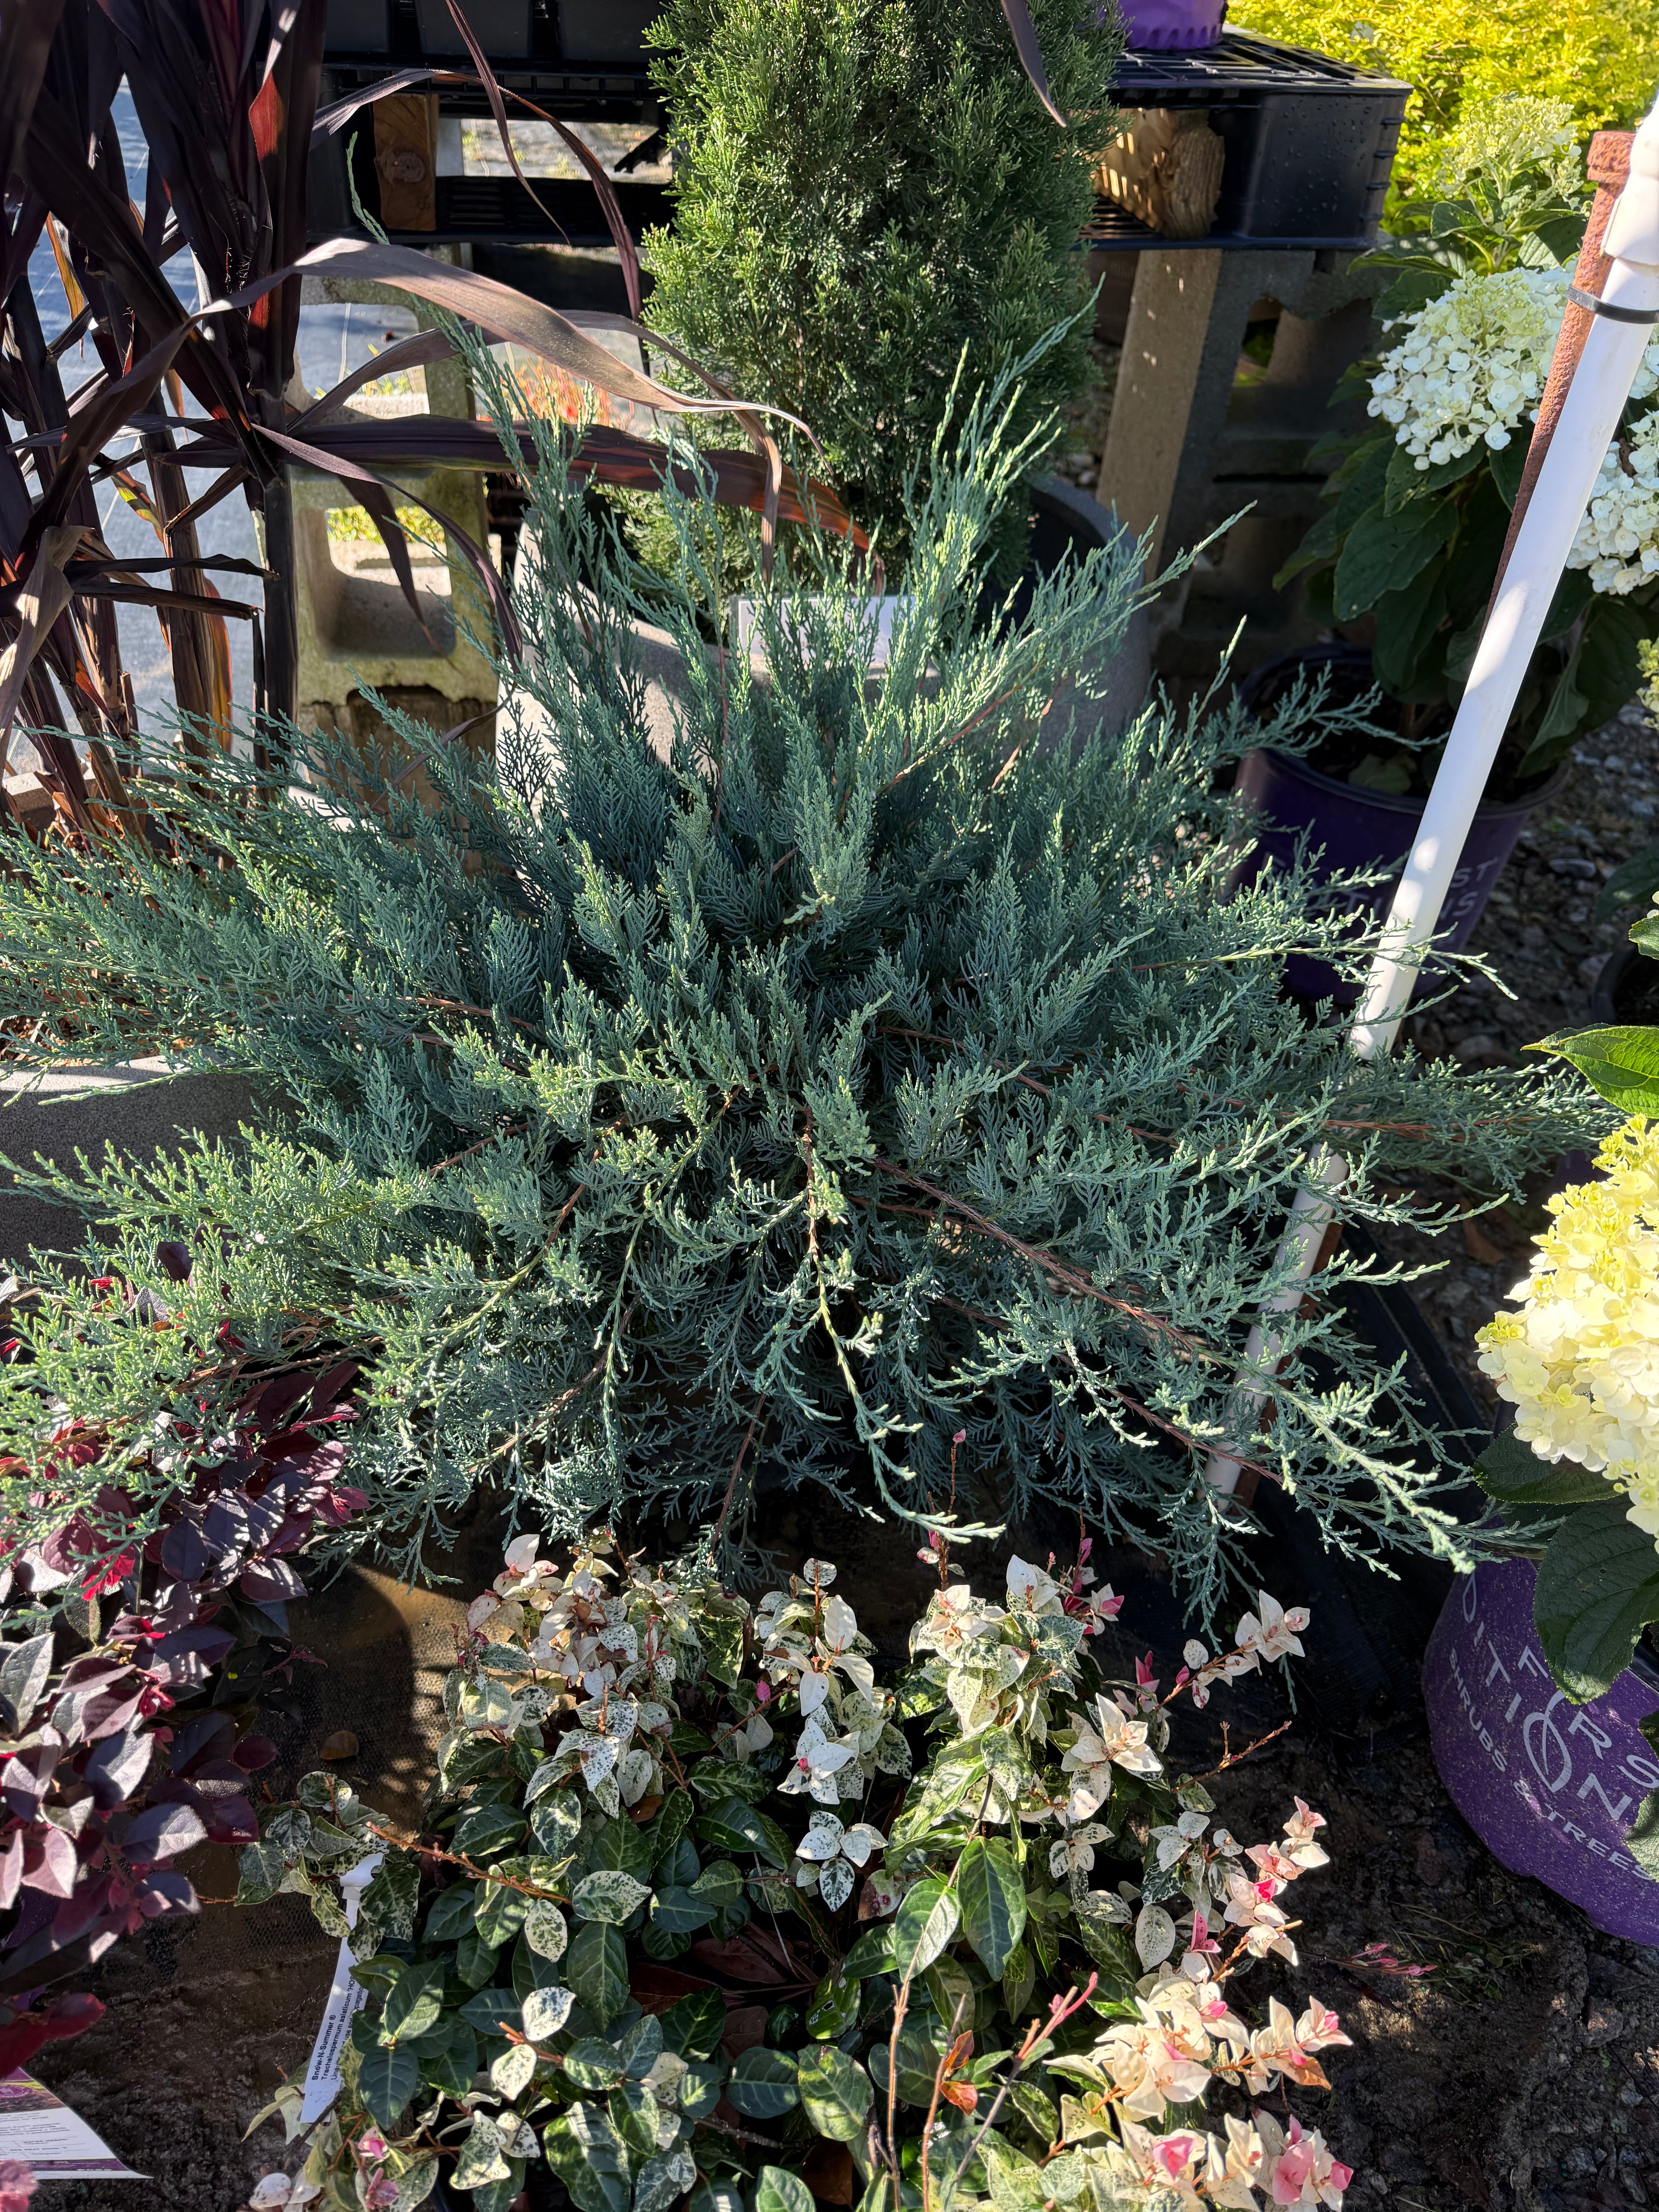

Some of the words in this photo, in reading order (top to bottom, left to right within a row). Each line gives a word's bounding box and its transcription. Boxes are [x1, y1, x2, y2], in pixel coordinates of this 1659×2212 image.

[1449, 1646, 1508, 1773] SHRUBS
[1513, 1778, 1535, 1804] &
[1545, 1803, 1654, 1881] TREES
[1462, 1573, 1632, 1820] DITION
[311, 2022, 334, 2080] Snow-N-Summer
[321, 2024, 343, 2080] Trachelospermum
[340, 1993, 352, 2022] asiaticum
[347, 1976, 356, 1991] 'HOS
